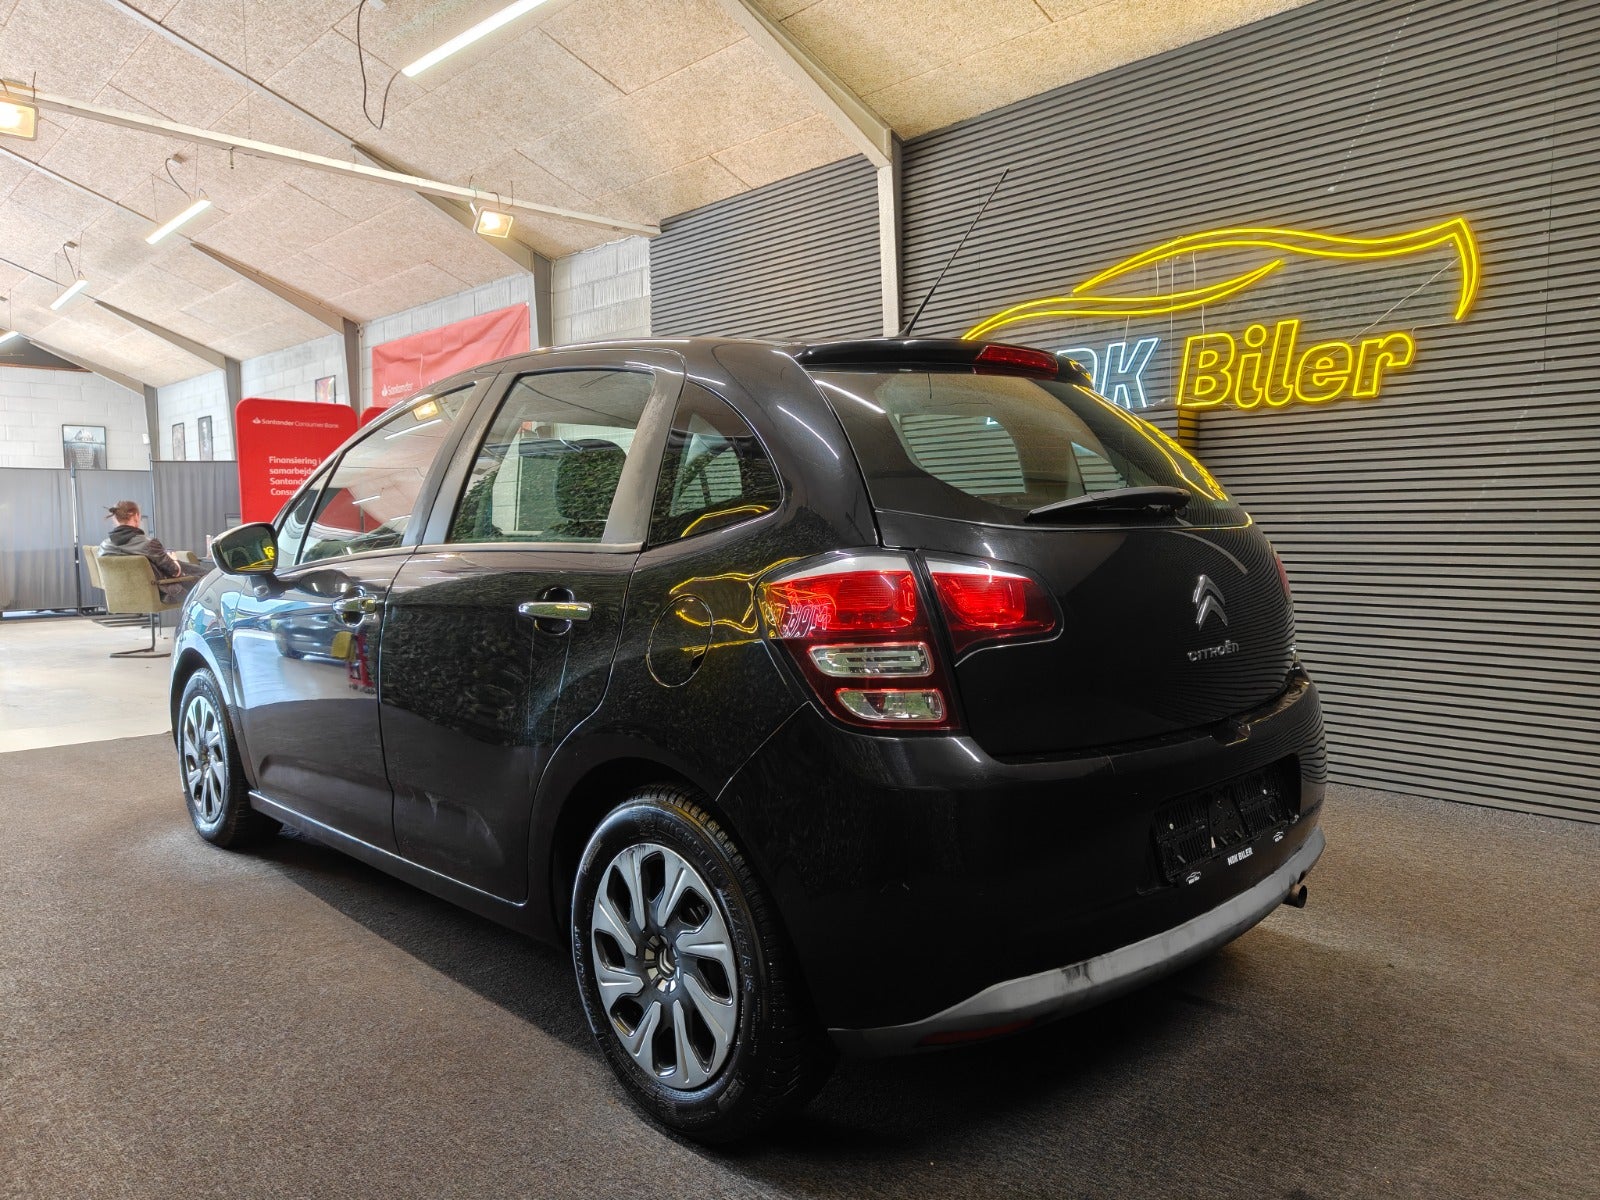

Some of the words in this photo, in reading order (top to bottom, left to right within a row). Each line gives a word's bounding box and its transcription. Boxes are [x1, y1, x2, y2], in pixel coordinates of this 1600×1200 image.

[1057, 337, 1161, 409] DK
[1177, 318, 1416, 409] Biler
[261, 418, 294, 426] Santander
[268, 456, 318, 466] Finansiering
